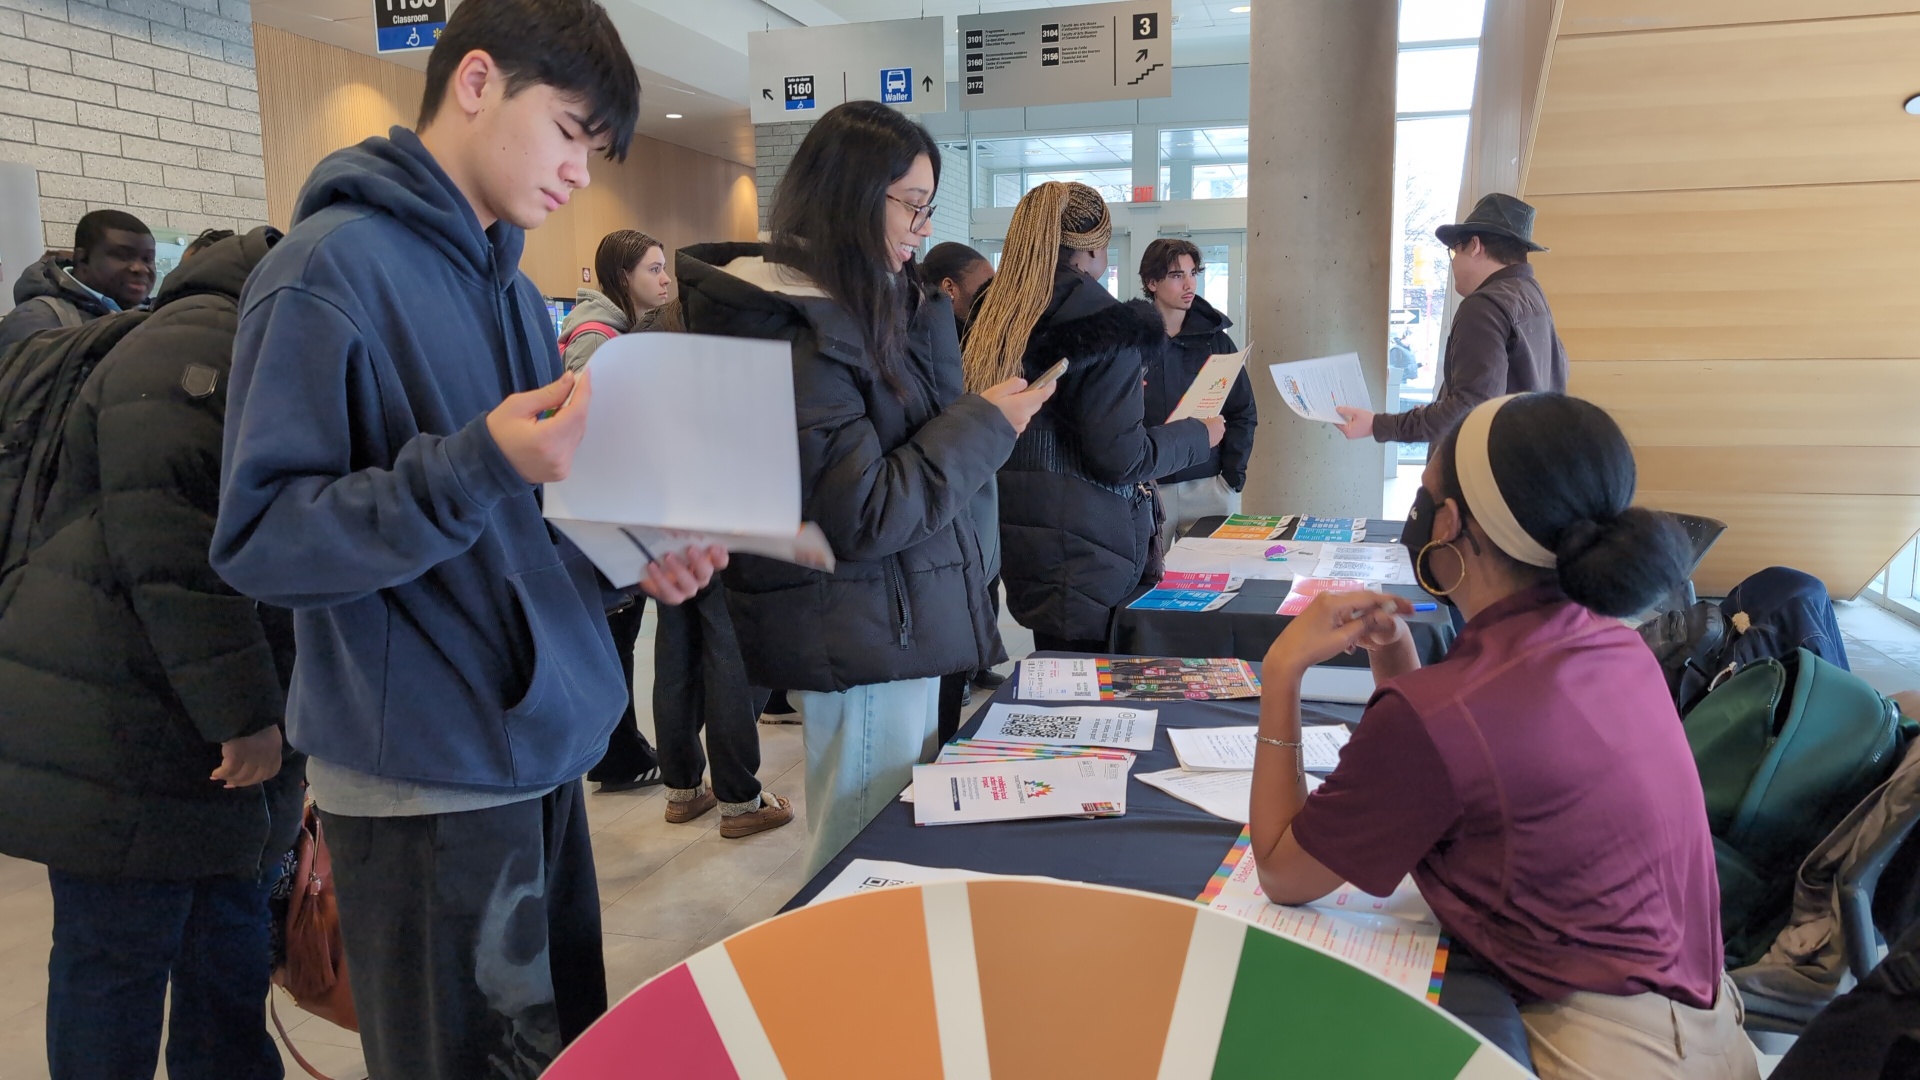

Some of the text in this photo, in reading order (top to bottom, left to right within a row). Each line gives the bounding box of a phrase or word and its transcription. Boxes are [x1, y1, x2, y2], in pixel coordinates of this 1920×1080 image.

[392, 14, 429, 24] Classroom
[1140, 18, 1150, 35] 3
[1042, 29, 1058, 37] 3104
[968, 58, 982, 66] 3160
[788, 82, 812, 95] 1160
[968, 81, 983, 89] 3172
[885, 93, 908, 102] Waller
[1134, 186, 1153, 202] EXIT
